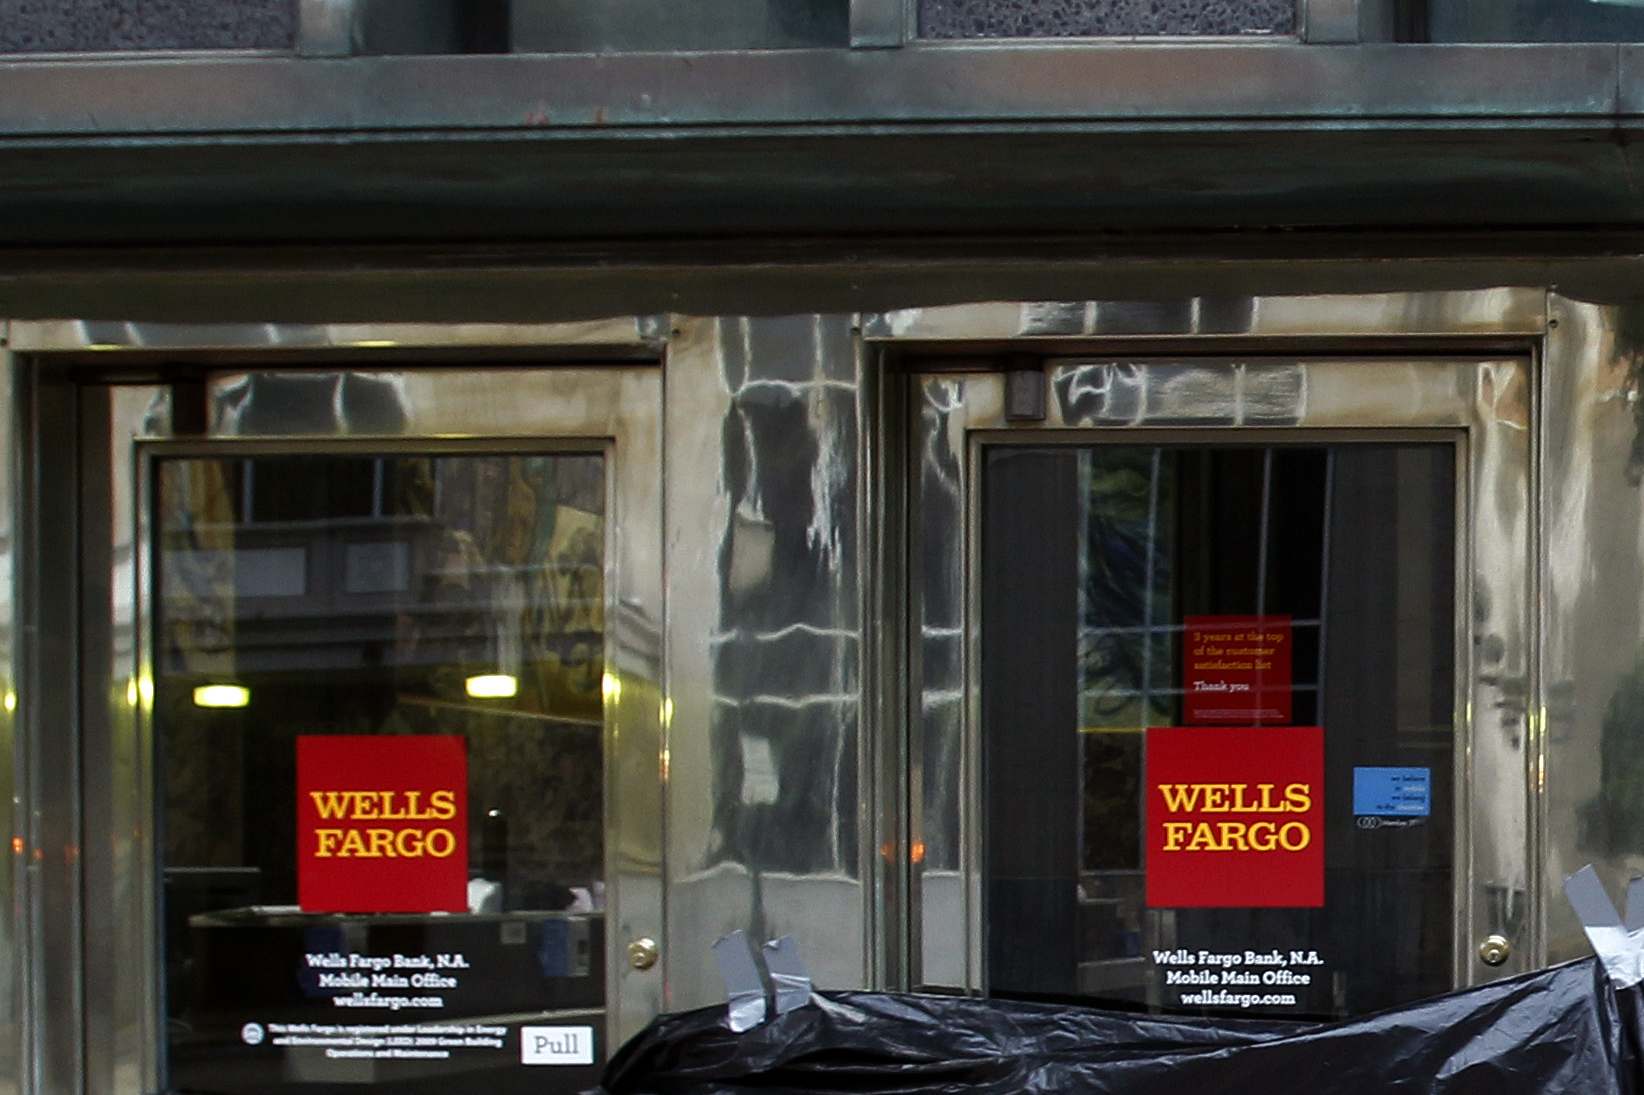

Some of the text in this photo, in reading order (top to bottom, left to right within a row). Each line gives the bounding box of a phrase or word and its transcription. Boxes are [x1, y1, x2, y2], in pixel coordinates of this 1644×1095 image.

[1193, 681, 1249, 693] Thank you
[310, 791, 456, 819] WELLS
[1158, 784, 1311, 812] WELLS
[315, 829, 455, 857] FARGO
[1163, 822, 1310, 850] FARGO
[306, 953, 469, 971] Wells Fargo Bank, N.A.
[1153, 950, 1323, 967] Wells Fargo Bank, N.A.
[319, 973, 457, 987] Mobile Main Office
[1166, 970, 1310, 984] Mobile Main Office
[333, 992, 443, 1010] wellsfargo.com
[1181, 990, 1296, 1007] wellsfargo.com
[535, 1032, 579, 1054] Pull
